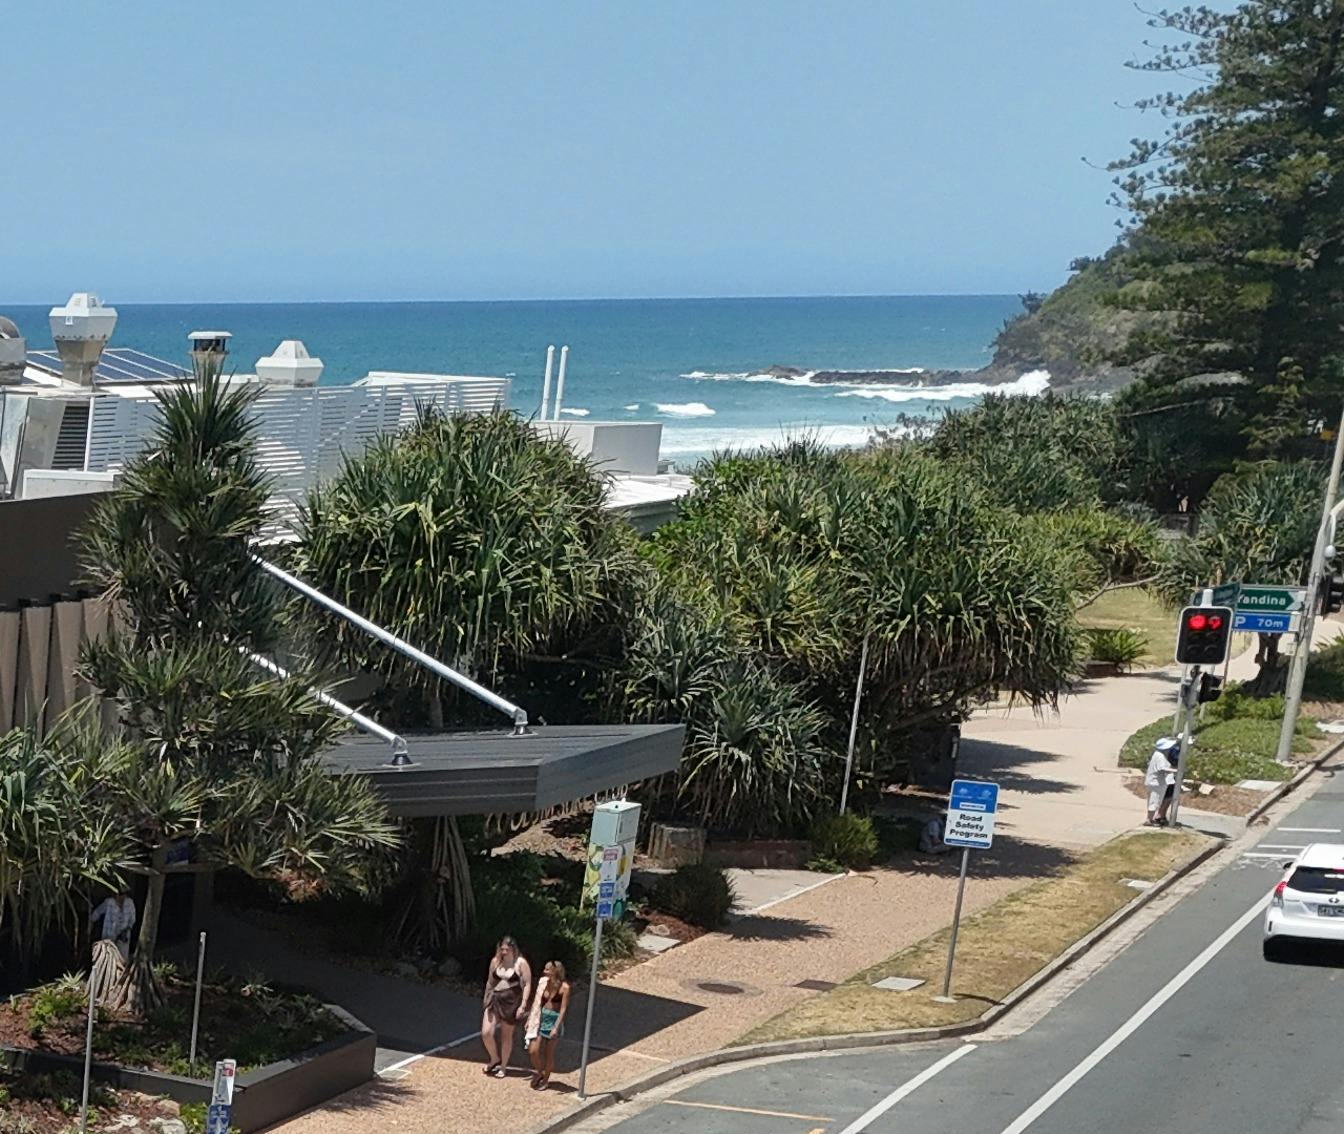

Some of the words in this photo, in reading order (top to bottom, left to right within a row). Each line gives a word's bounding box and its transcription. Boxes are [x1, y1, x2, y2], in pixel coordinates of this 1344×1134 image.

[1235, 616, 1246, 627] P
[1257, 618, 1284, 628] 70m
[960, 814, 983, 822] Road
[955, 821, 984, 831] Safety
[950, 828, 988, 839] Program
